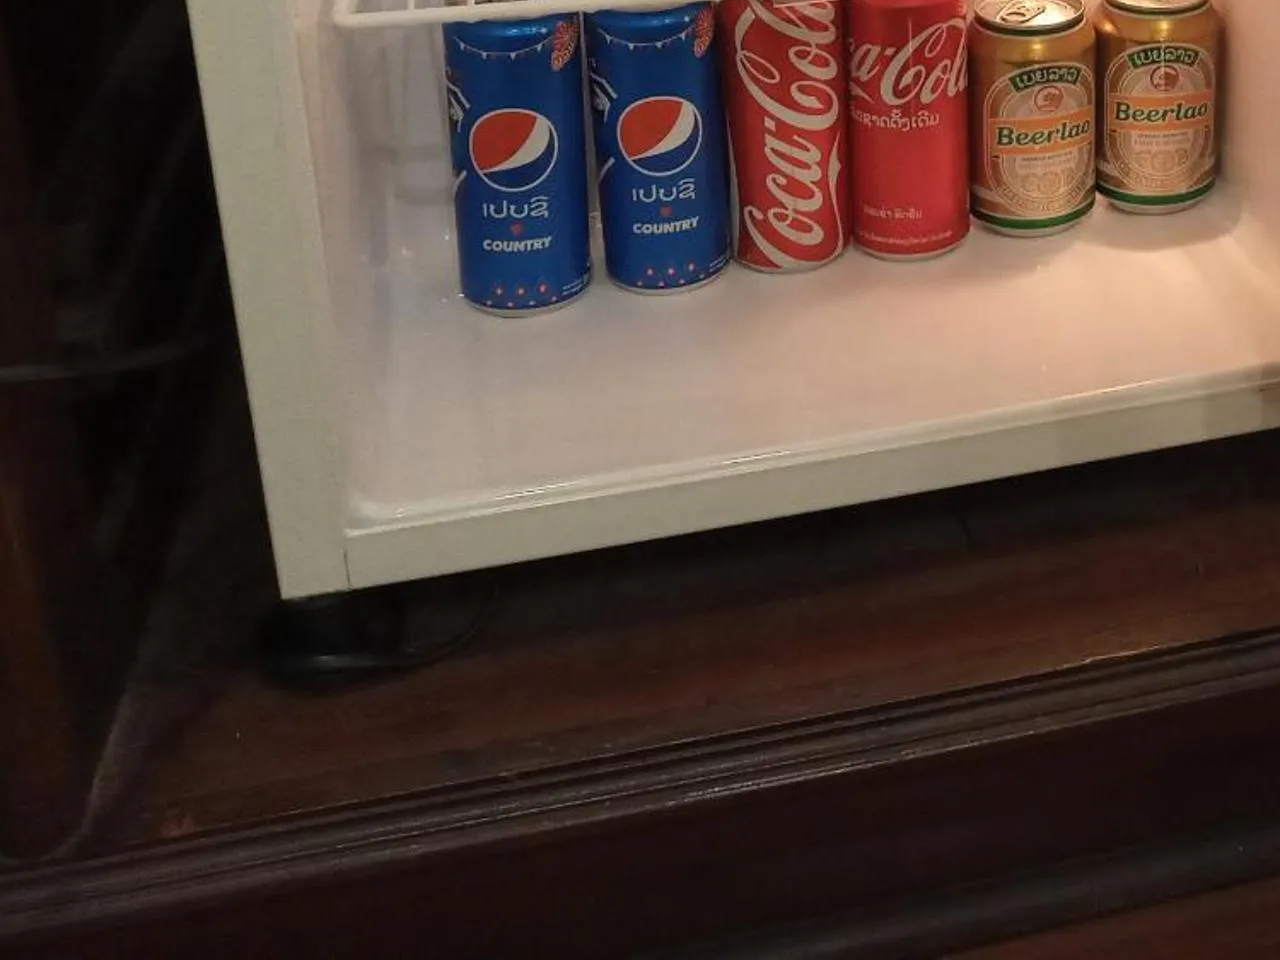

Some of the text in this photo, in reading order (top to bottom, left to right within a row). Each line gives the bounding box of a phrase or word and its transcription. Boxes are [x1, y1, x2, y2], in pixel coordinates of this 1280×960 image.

[1114, 100, 1209, 124] Beerlao
[995, 118, 1092, 146] Beerlao
[632, 216, 700, 234] COUNTRY
[482, 236, 552, 253] COUNTRY
